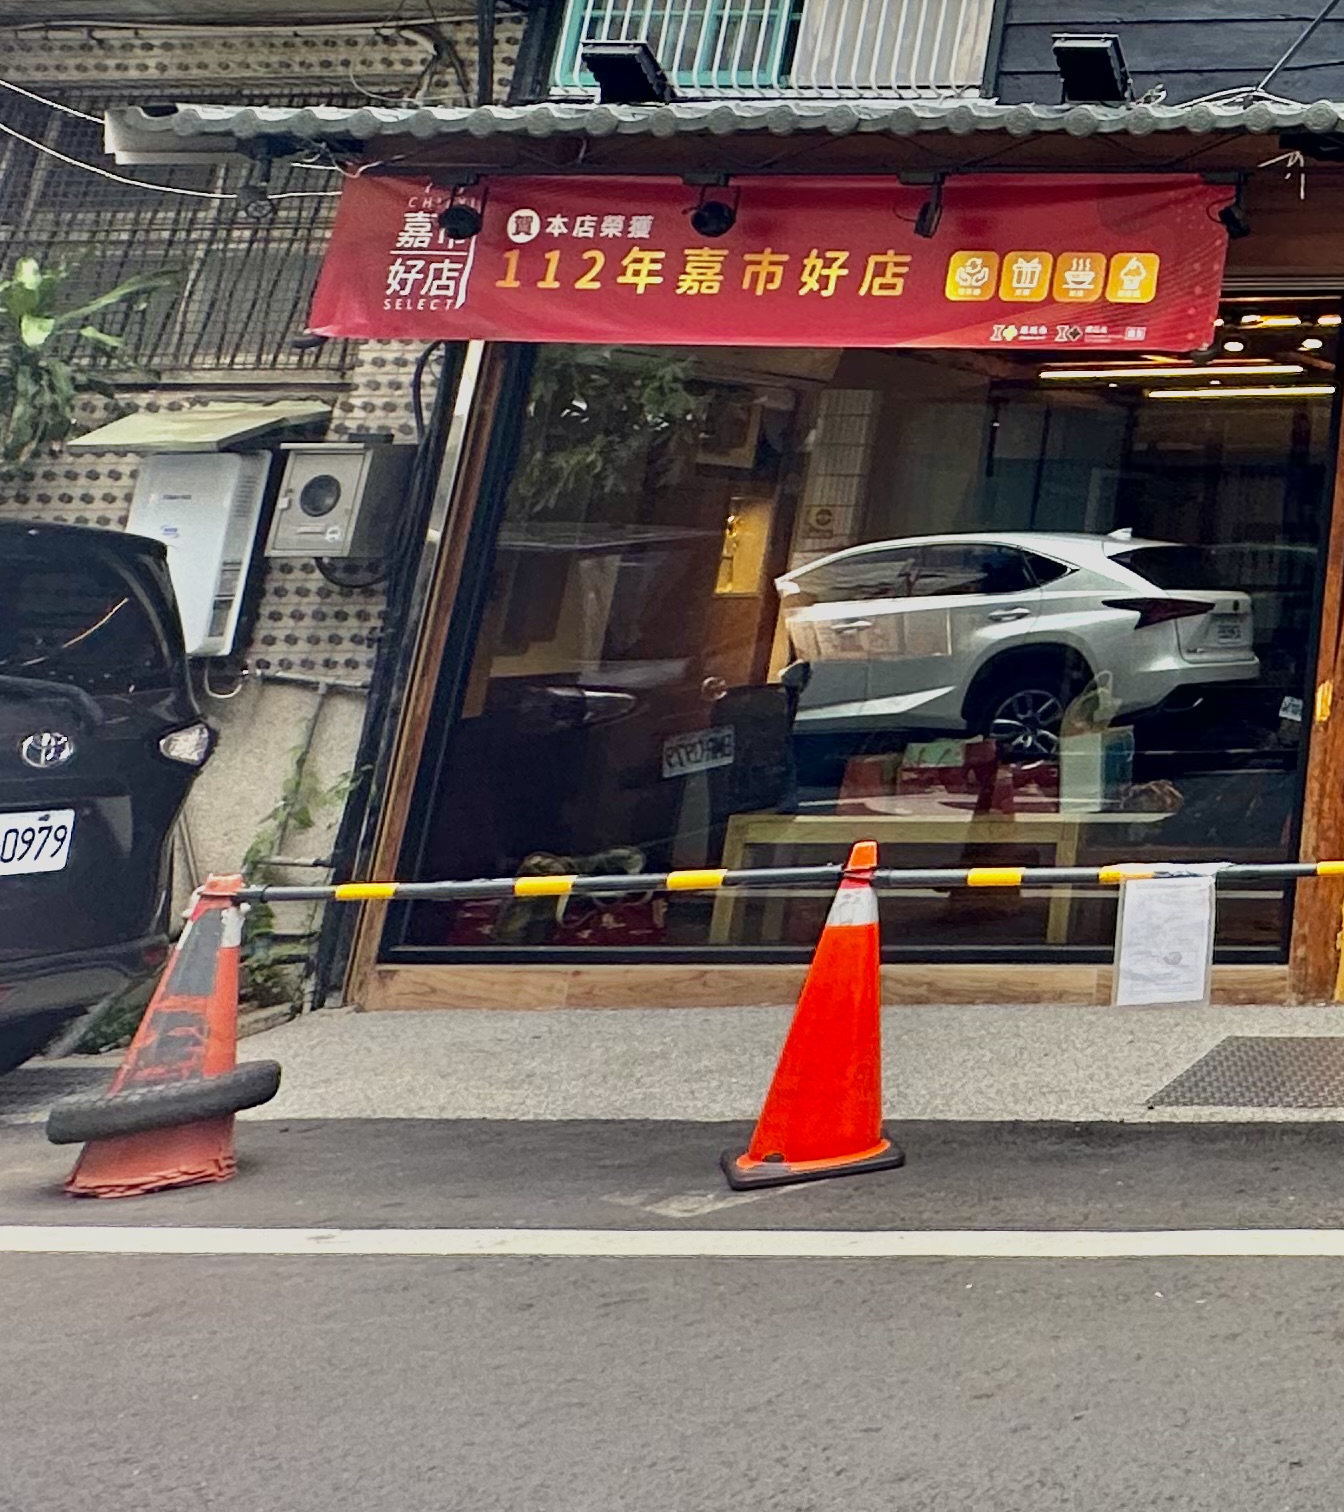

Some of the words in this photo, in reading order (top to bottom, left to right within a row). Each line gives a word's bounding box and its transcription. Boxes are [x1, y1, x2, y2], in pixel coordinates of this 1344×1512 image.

[386, 257, 463, 296] 好店
[384, 299, 453, 310] SELECT
[0, 825, 68, 863] 0979
